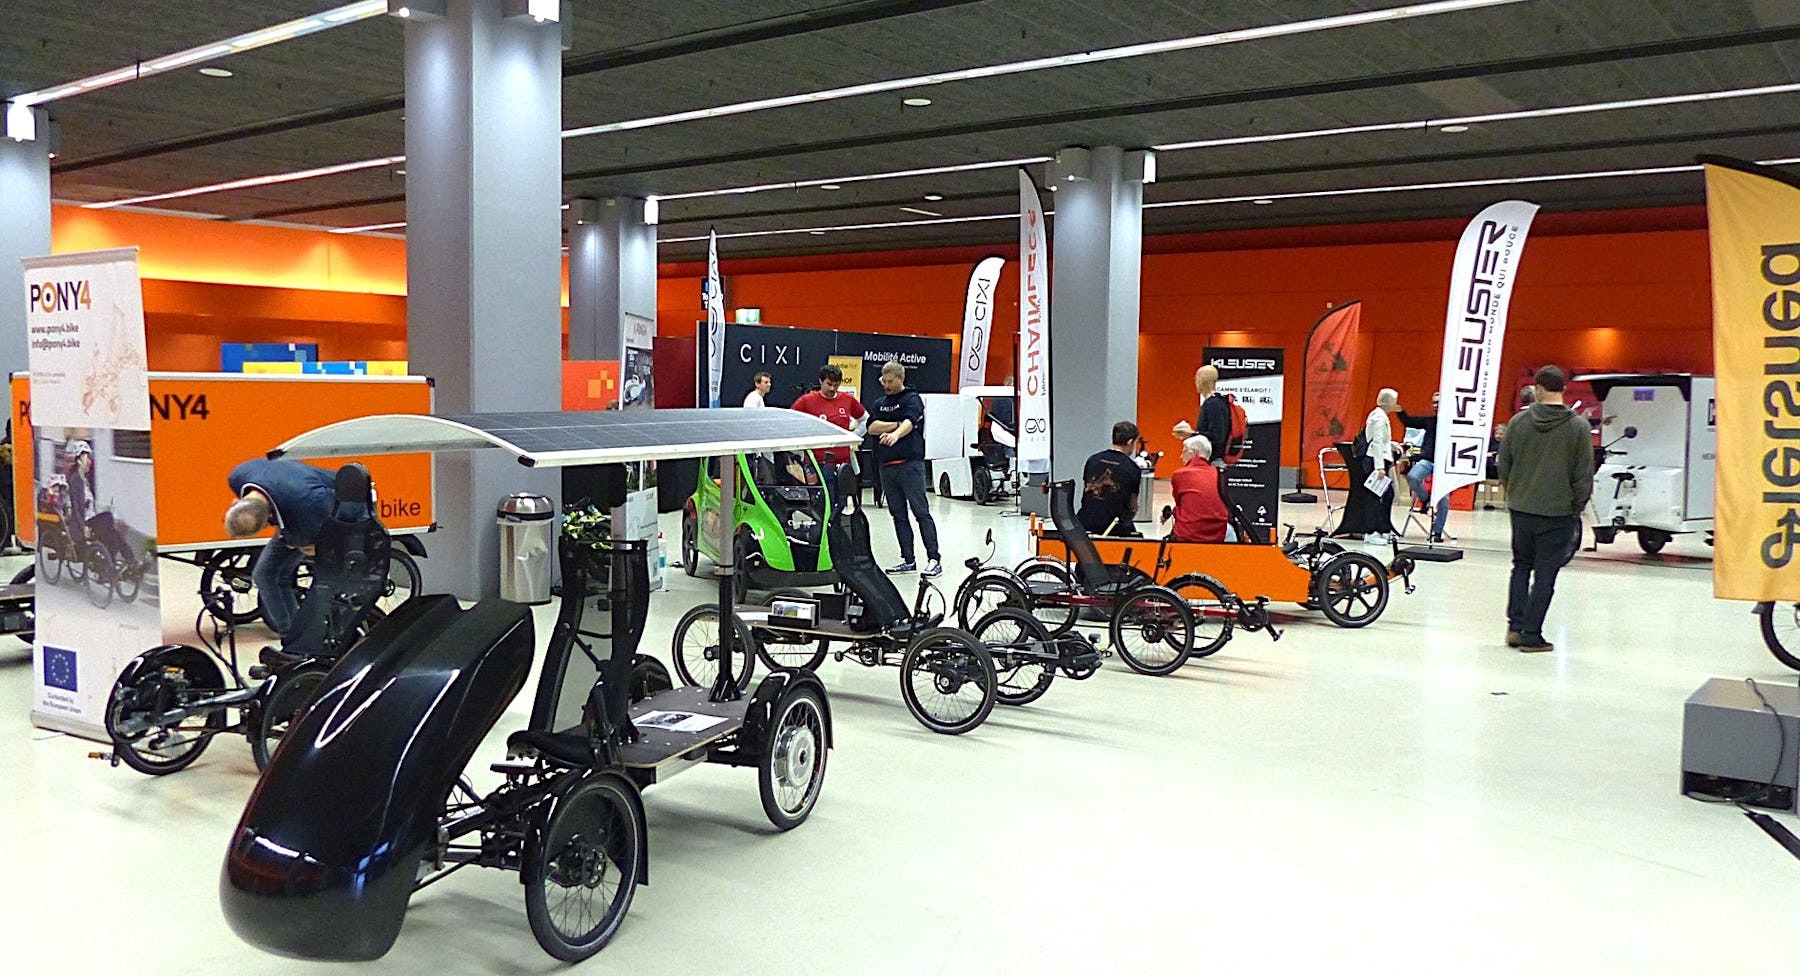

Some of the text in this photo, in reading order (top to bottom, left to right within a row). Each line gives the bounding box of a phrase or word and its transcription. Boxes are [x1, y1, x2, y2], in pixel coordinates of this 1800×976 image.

[30, 279, 91, 313] PONY4
[974, 278, 991, 321] CIXI
[1489, 293, 1502, 334] MONDE
[1496, 269, 1508, 289] QUI
[31, 322, 80, 336] www.pony4.bike
[1452, 220, 1508, 426] KLEUSTER
[31, 337, 81, 351] info@pony4.bike
[740, 344, 800, 365] CIXI
[864, 351, 927, 364] Mobilité Active
[1211, 358, 1276, 370] KLEUSTER
[150, 393, 210, 421] NY4
